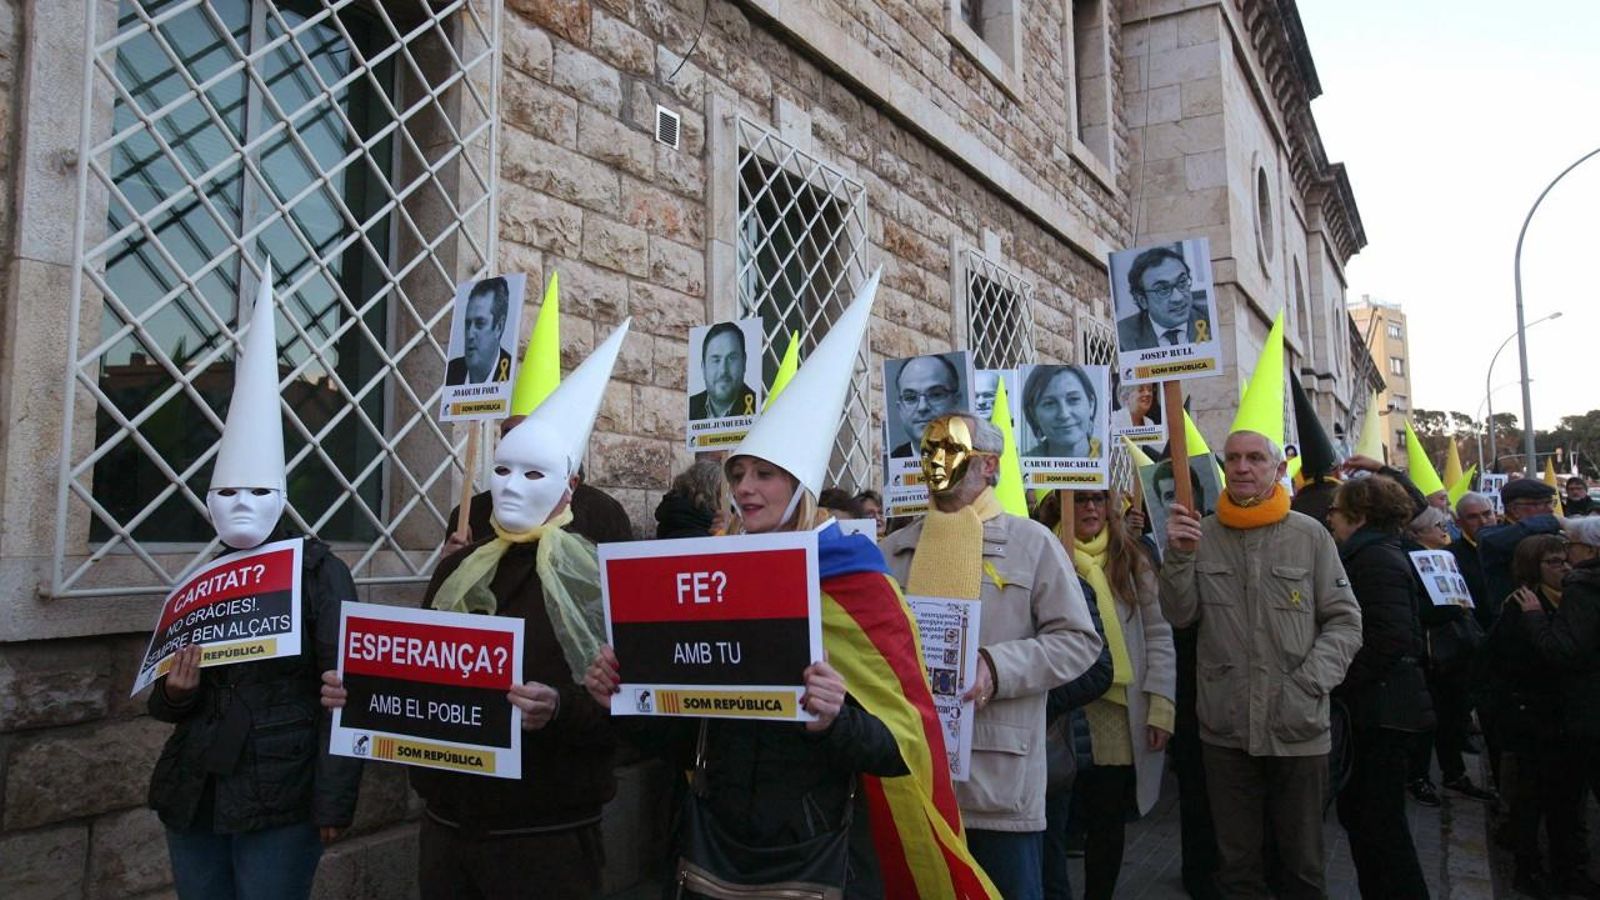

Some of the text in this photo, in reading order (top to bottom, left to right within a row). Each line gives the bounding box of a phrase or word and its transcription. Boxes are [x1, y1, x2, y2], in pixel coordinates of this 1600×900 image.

[1140, 347, 1195, 361] JOSEP RULL
[1151, 361, 1208, 375] SOM REPÚBLICA
[1024, 460, 1051, 468] CARME
[173, 564, 266, 613] CARITAT?
[676, 570, 727, 604] FE?
[166, 620, 183, 639] NO
[191, 624, 224, 643] BEN
[228, 614, 291, 638] ALÇATS
[203, 645, 265, 661] REPÚBLICA
[348, 631, 508, 679] ESPERANÇA?
[673, 641, 741, 664] AMB TU
[369, 693, 482, 726] AMB EL POBLE
[683, 695, 783, 711] SOM REPÚBLICA
[397, 745, 484, 767] SOM REPÚBLICA
